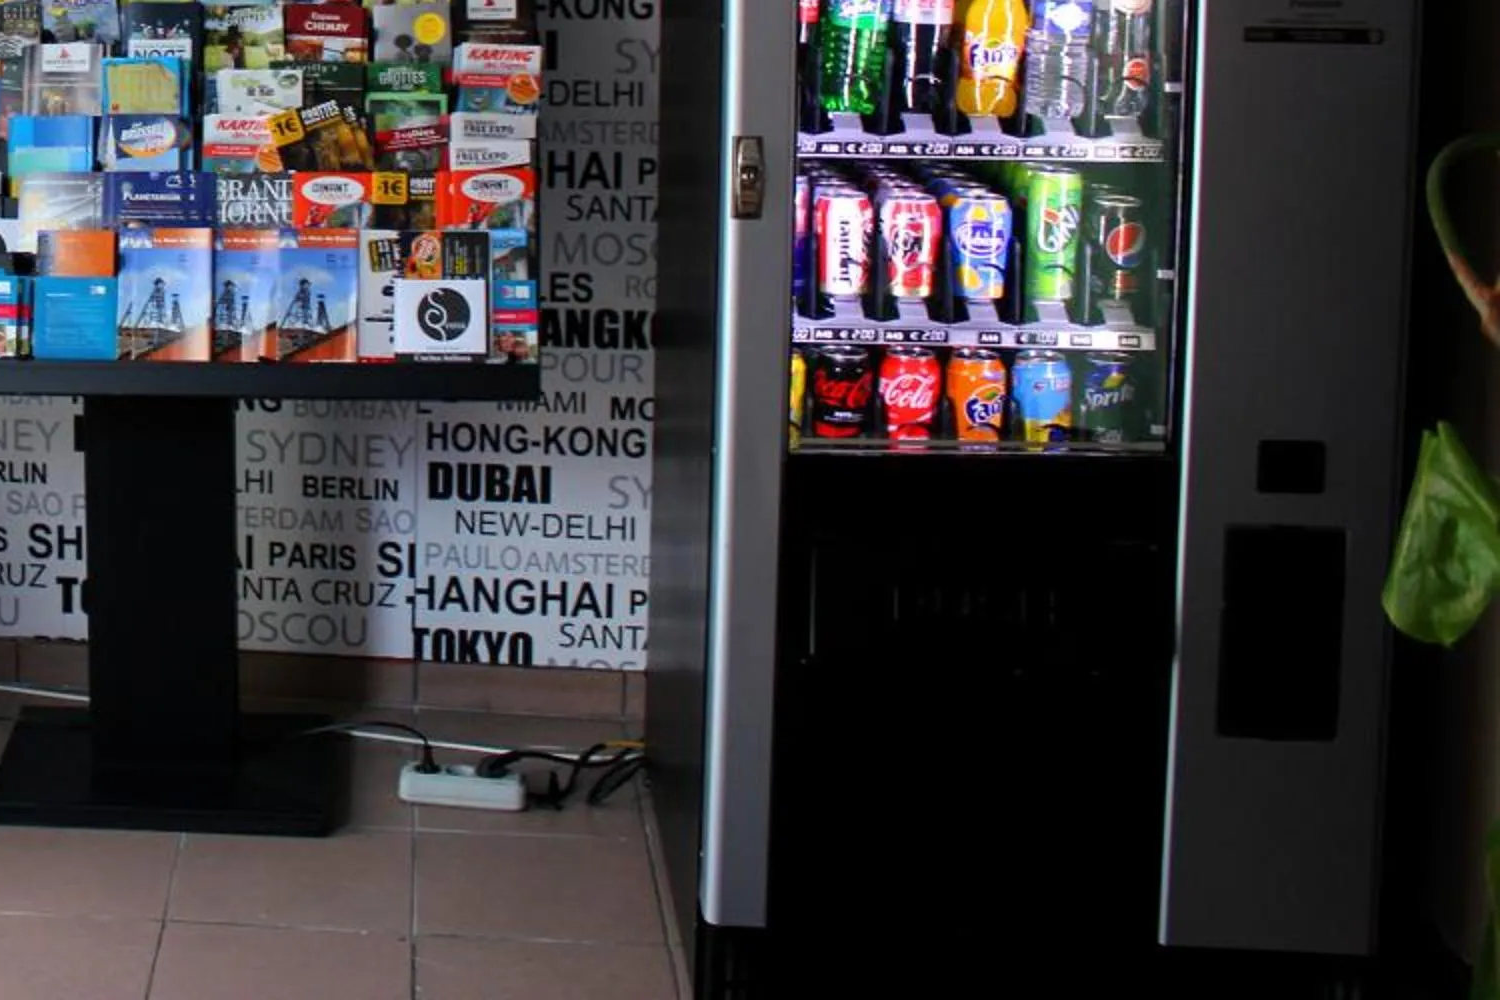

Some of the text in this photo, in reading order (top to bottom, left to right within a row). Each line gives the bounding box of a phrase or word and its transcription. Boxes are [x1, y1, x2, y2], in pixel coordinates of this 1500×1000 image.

[247, 430, 413, 469] SYDNEY
[428, 423, 646, 458] HONG-KONG
[456, 509, 635, 541] NEW-DELHI
[269, 541, 355, 570] PARIS
[312, 580, 395, 608] CRUZ
[413, 628, 533, 666] TOKYO
